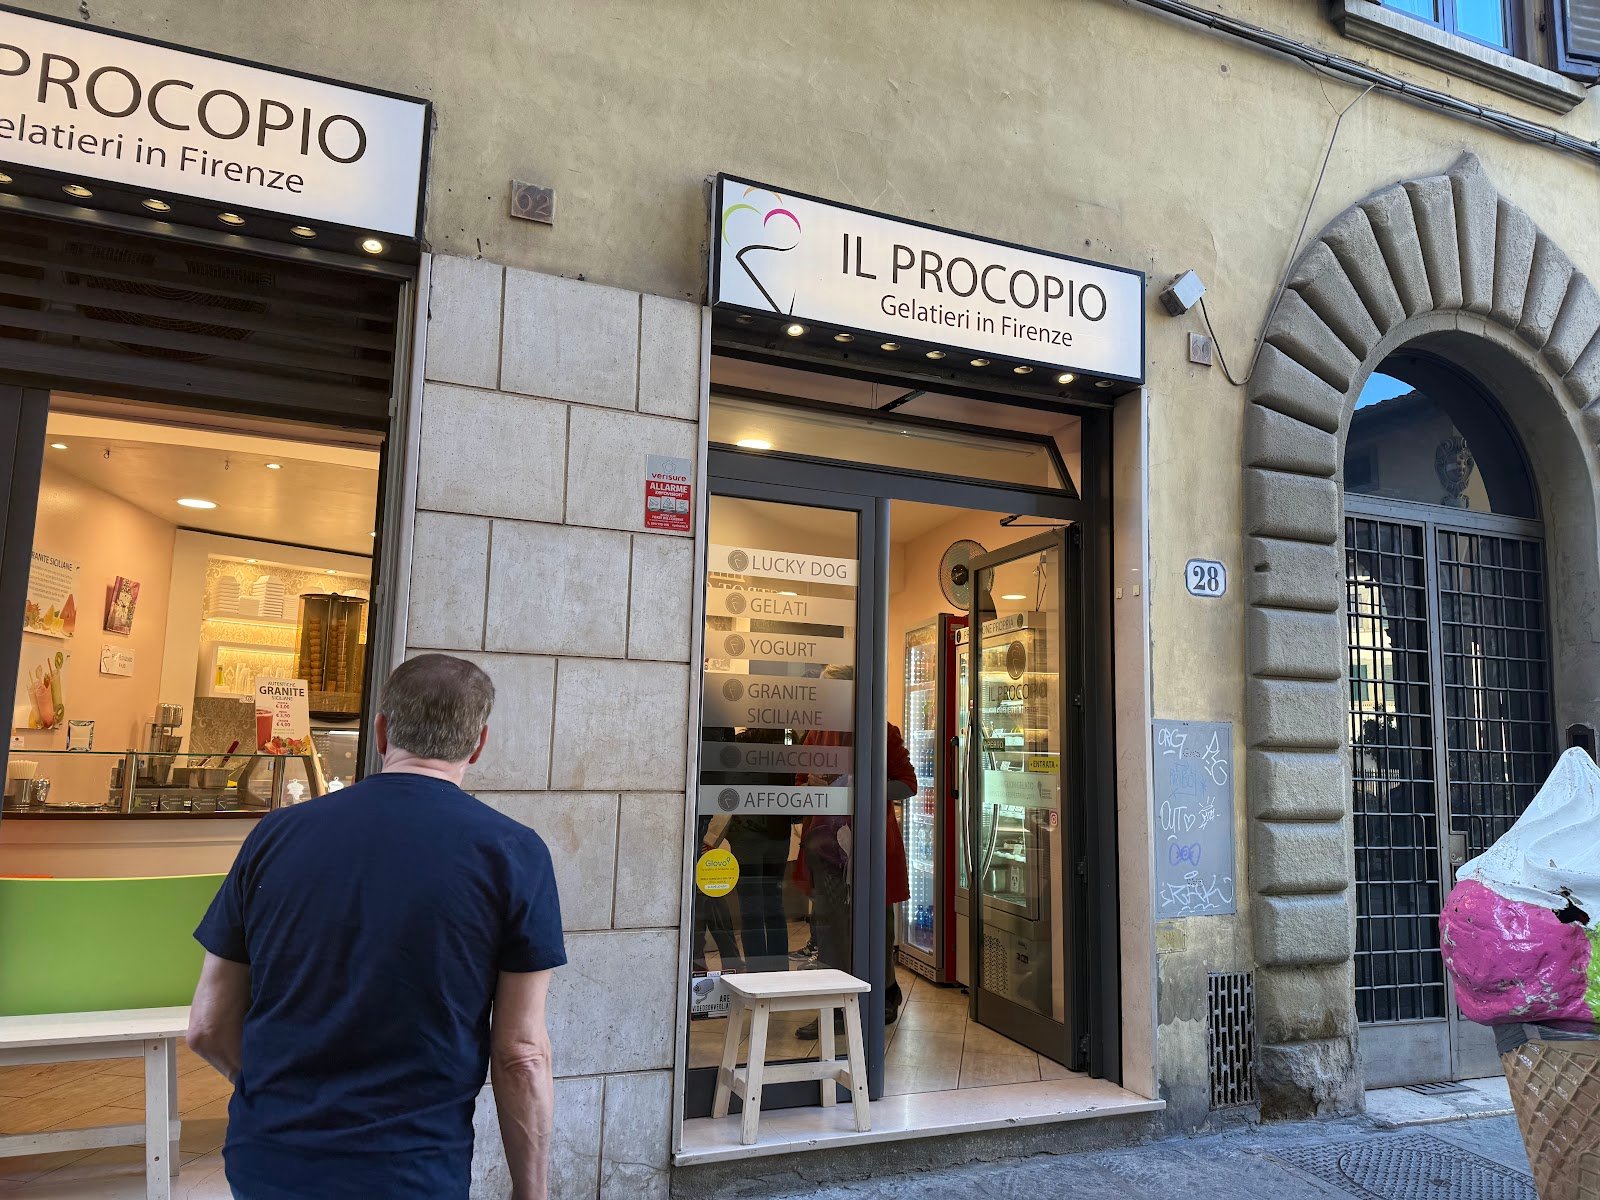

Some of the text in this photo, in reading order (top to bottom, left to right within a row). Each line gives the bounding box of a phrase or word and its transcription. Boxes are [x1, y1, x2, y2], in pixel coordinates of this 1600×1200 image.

[135, 138, 167, 168] in
[180, 145, 305, 194] Firenze
[842, 233, 1107, 322] IL PROCOPIO
[880, 294, 1073, 347] Gelatieri in Firenze
[651, 473, 687, 482] verisure
[650, 482, 688, 493] ALLARME
[752, 555, 847, 579] LUCKY DOG
[1192, 565, 1219, 591] 28
[750, 597, 808, 616] GELATI
[750, 639, 817, 657] YOGURT
[260, 686, 305, 697] GRANITE
[748, 683, 817, 701] GRANITE
[989, 682, 1047, 702] IL PROCOPIO
[747, 707, 823, 726] SICILIANE
[745, 750, 838, 768] GHIACCIOLI
[1033, 761, 1056, 769] ENTRATA
[744, 792, 828, 809] AFFOGATI
[705, 858, 728, 867] Glovo
